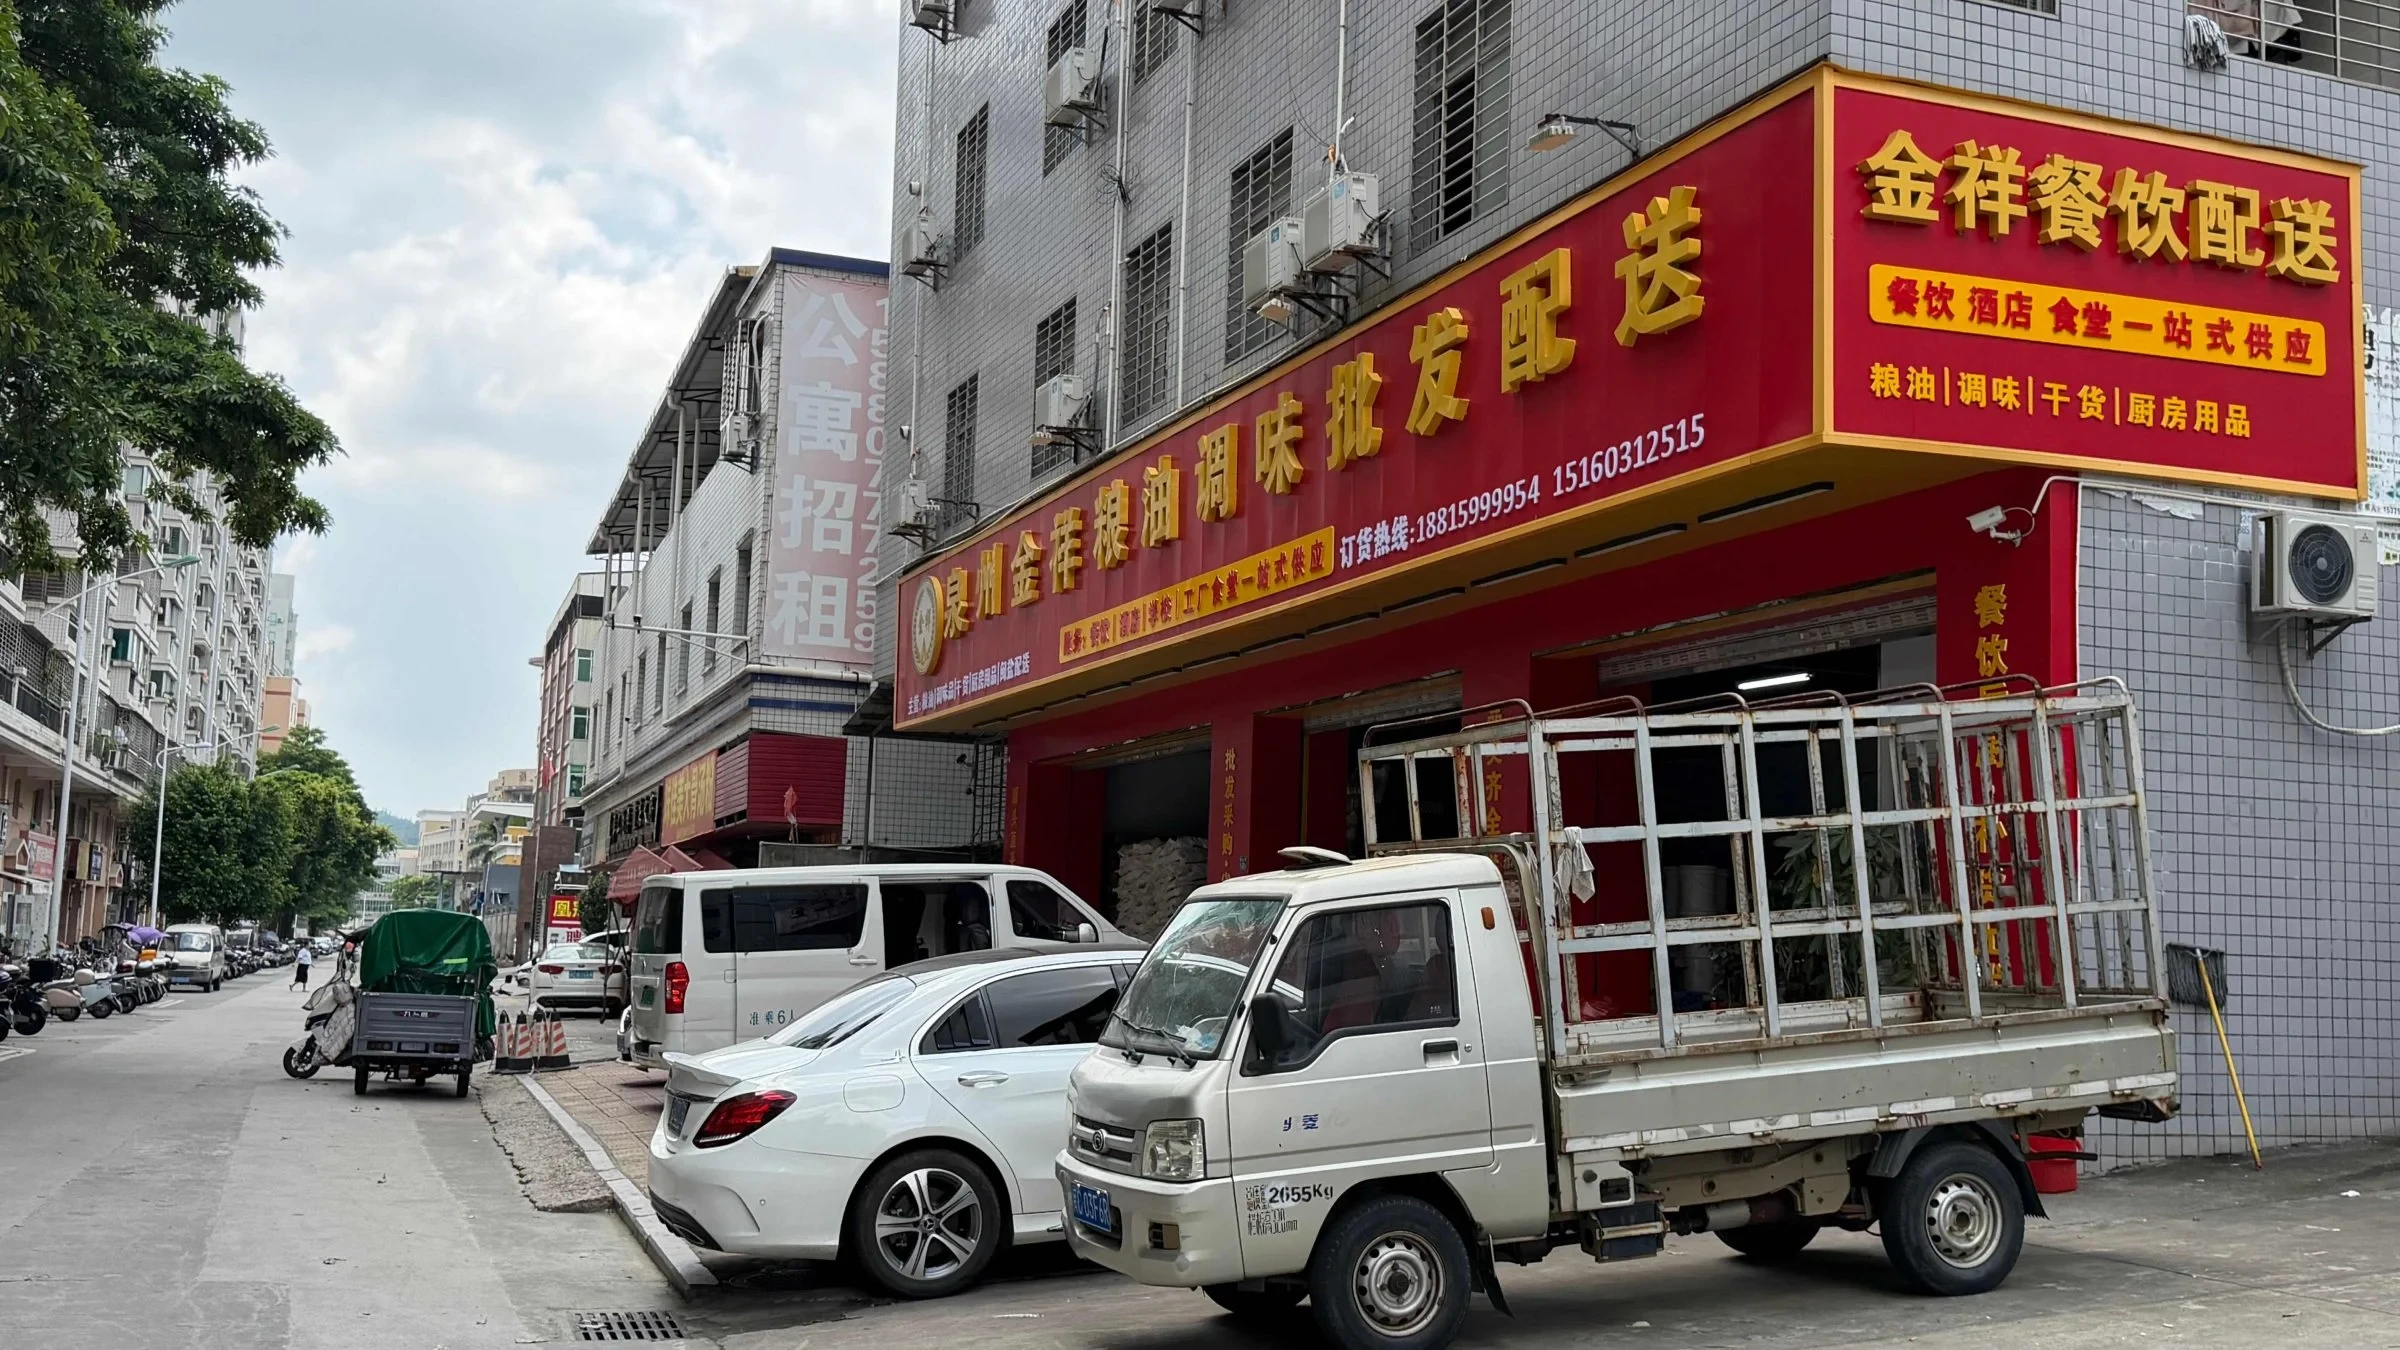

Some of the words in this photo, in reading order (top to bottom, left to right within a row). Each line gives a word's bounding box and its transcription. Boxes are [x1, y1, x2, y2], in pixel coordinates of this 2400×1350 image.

[1857, 130, 2340, 285] 金祥餐饮配送
[1888, 276, 1955, 320] 餐饮
[1968, 286, 2033, 329] 酒店
[2048, 297, 2112, 339] 食堂
[2123, 310, 2313, 365] 一站式供应
[769, 292, 869, 650] 公寓招租
[943, 186, 1705, 639] 泉州金祥粮油调味批发配送
[1552, 413, 1705, 498] 15160312515
